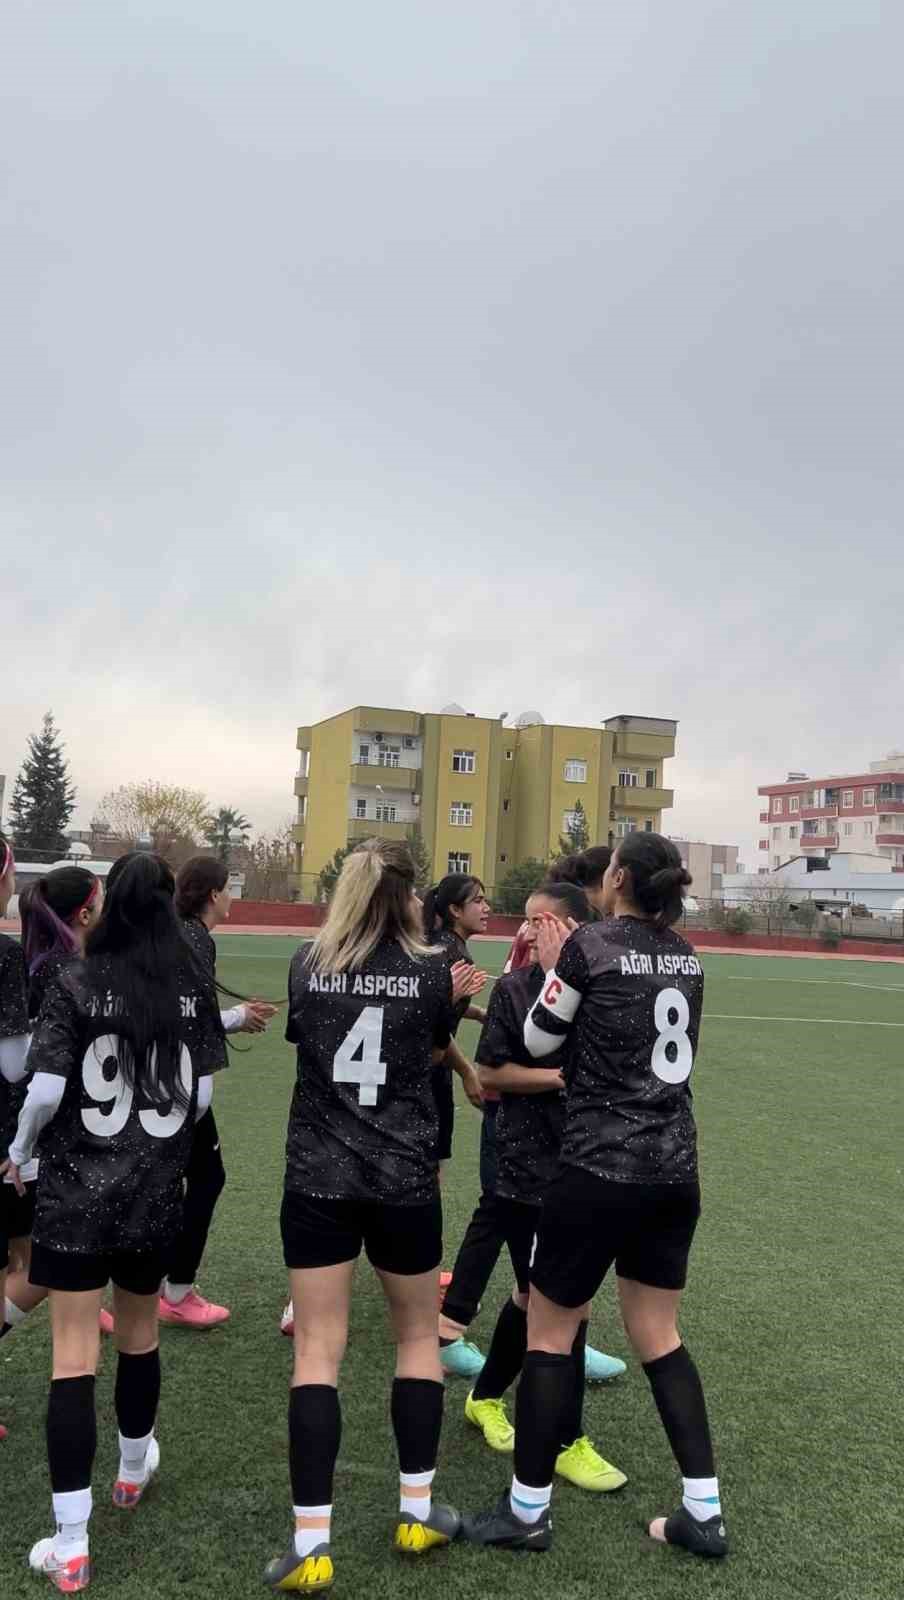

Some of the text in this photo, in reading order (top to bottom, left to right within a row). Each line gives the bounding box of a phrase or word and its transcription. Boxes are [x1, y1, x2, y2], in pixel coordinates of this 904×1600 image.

[620, 949, 653, 975] AĞRI
[352, 974, 420, 998] ASPGSK
[544, 980, 562, 1005] C
[651, 987, 693, 1084] 8
[333, 1006, 387, 1106] 4
